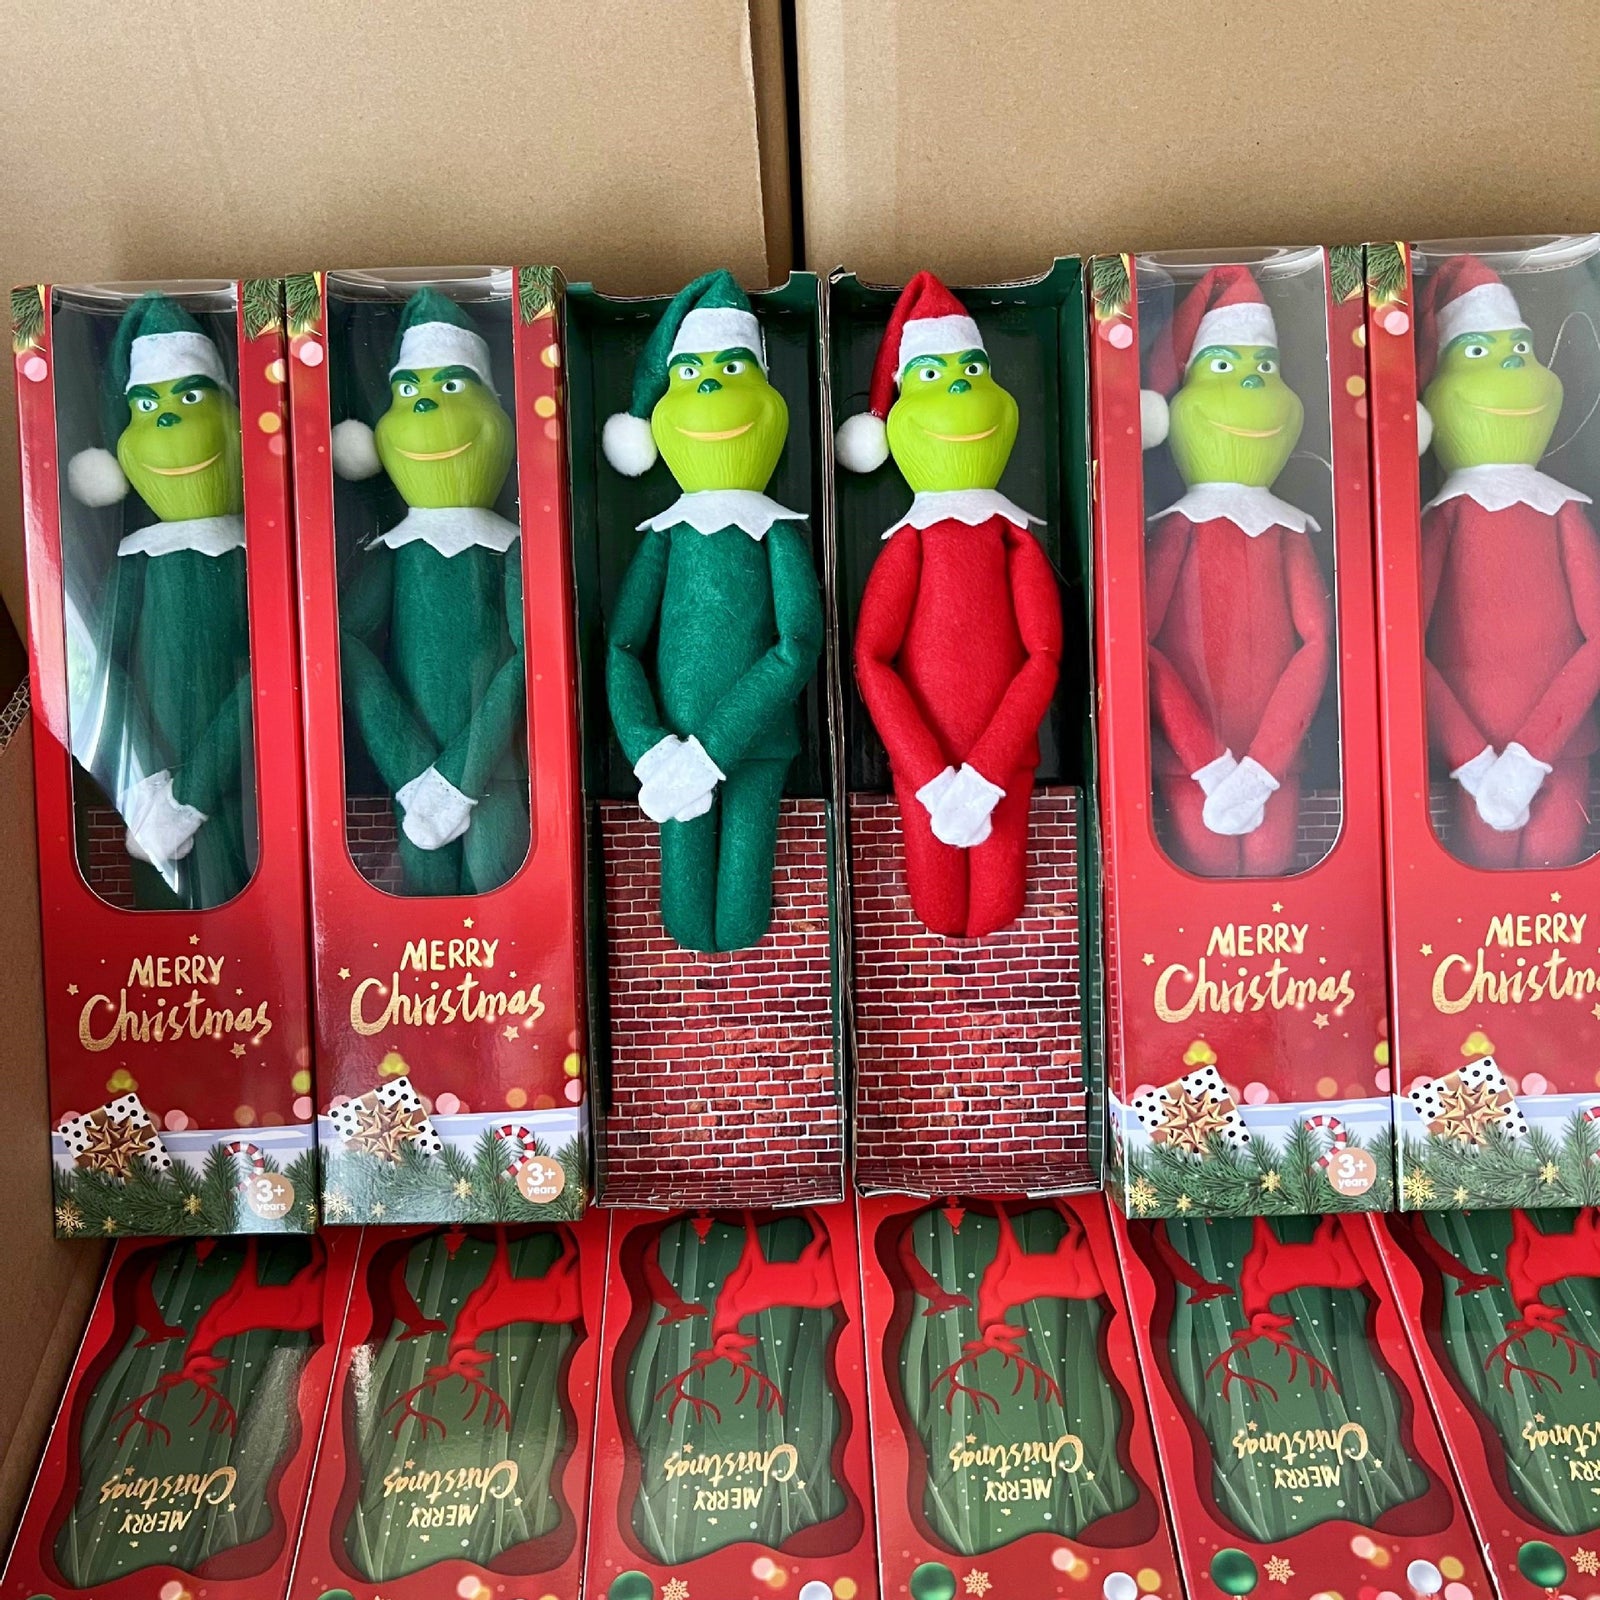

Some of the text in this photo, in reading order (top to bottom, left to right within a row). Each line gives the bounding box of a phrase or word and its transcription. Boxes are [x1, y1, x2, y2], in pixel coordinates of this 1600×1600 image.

[1207, 923, 1309, 957] MERRY
[1485, 913, 1587, 947] MERRY
[400, 938, 499, 971] MERRY
[127, 955, 225, 988] MERRY
[1432, 948, 1600, 1015] Christm
[351, 972, 546, 1036] Christmas
[1154, 957, 1355, 1023] Christmas
[79, 988, 273, 1052] Christmas
[527, 1162, 556, 1186] 3+
[1337, 1153, 1367, 1178] 3+
[256, 1179, 285, 1202] 3+
[527, 1186, 557, 1197] years
[1338, 1178, 1368, 1189] years
[257, 1203, 286, 1212] years
[949, 1434, 1084, 1478] Christmas
[1232, 1422, 1369, 1466] Christmas
[383, 1459, 519, 1504] Christmas
[664, 1443, 798, 1487] Christmas
[1274, 1464, 1341, 1489] MERRY
[100, 1466, 237, 1510] Christmas
[693, 1486, 763, 1511] MERRY
[984, 1477, 1053, 1502] MERRY
[118, 1510, 193, 1534] MERRY
[406, 1503, 479, 1528] MERRY
